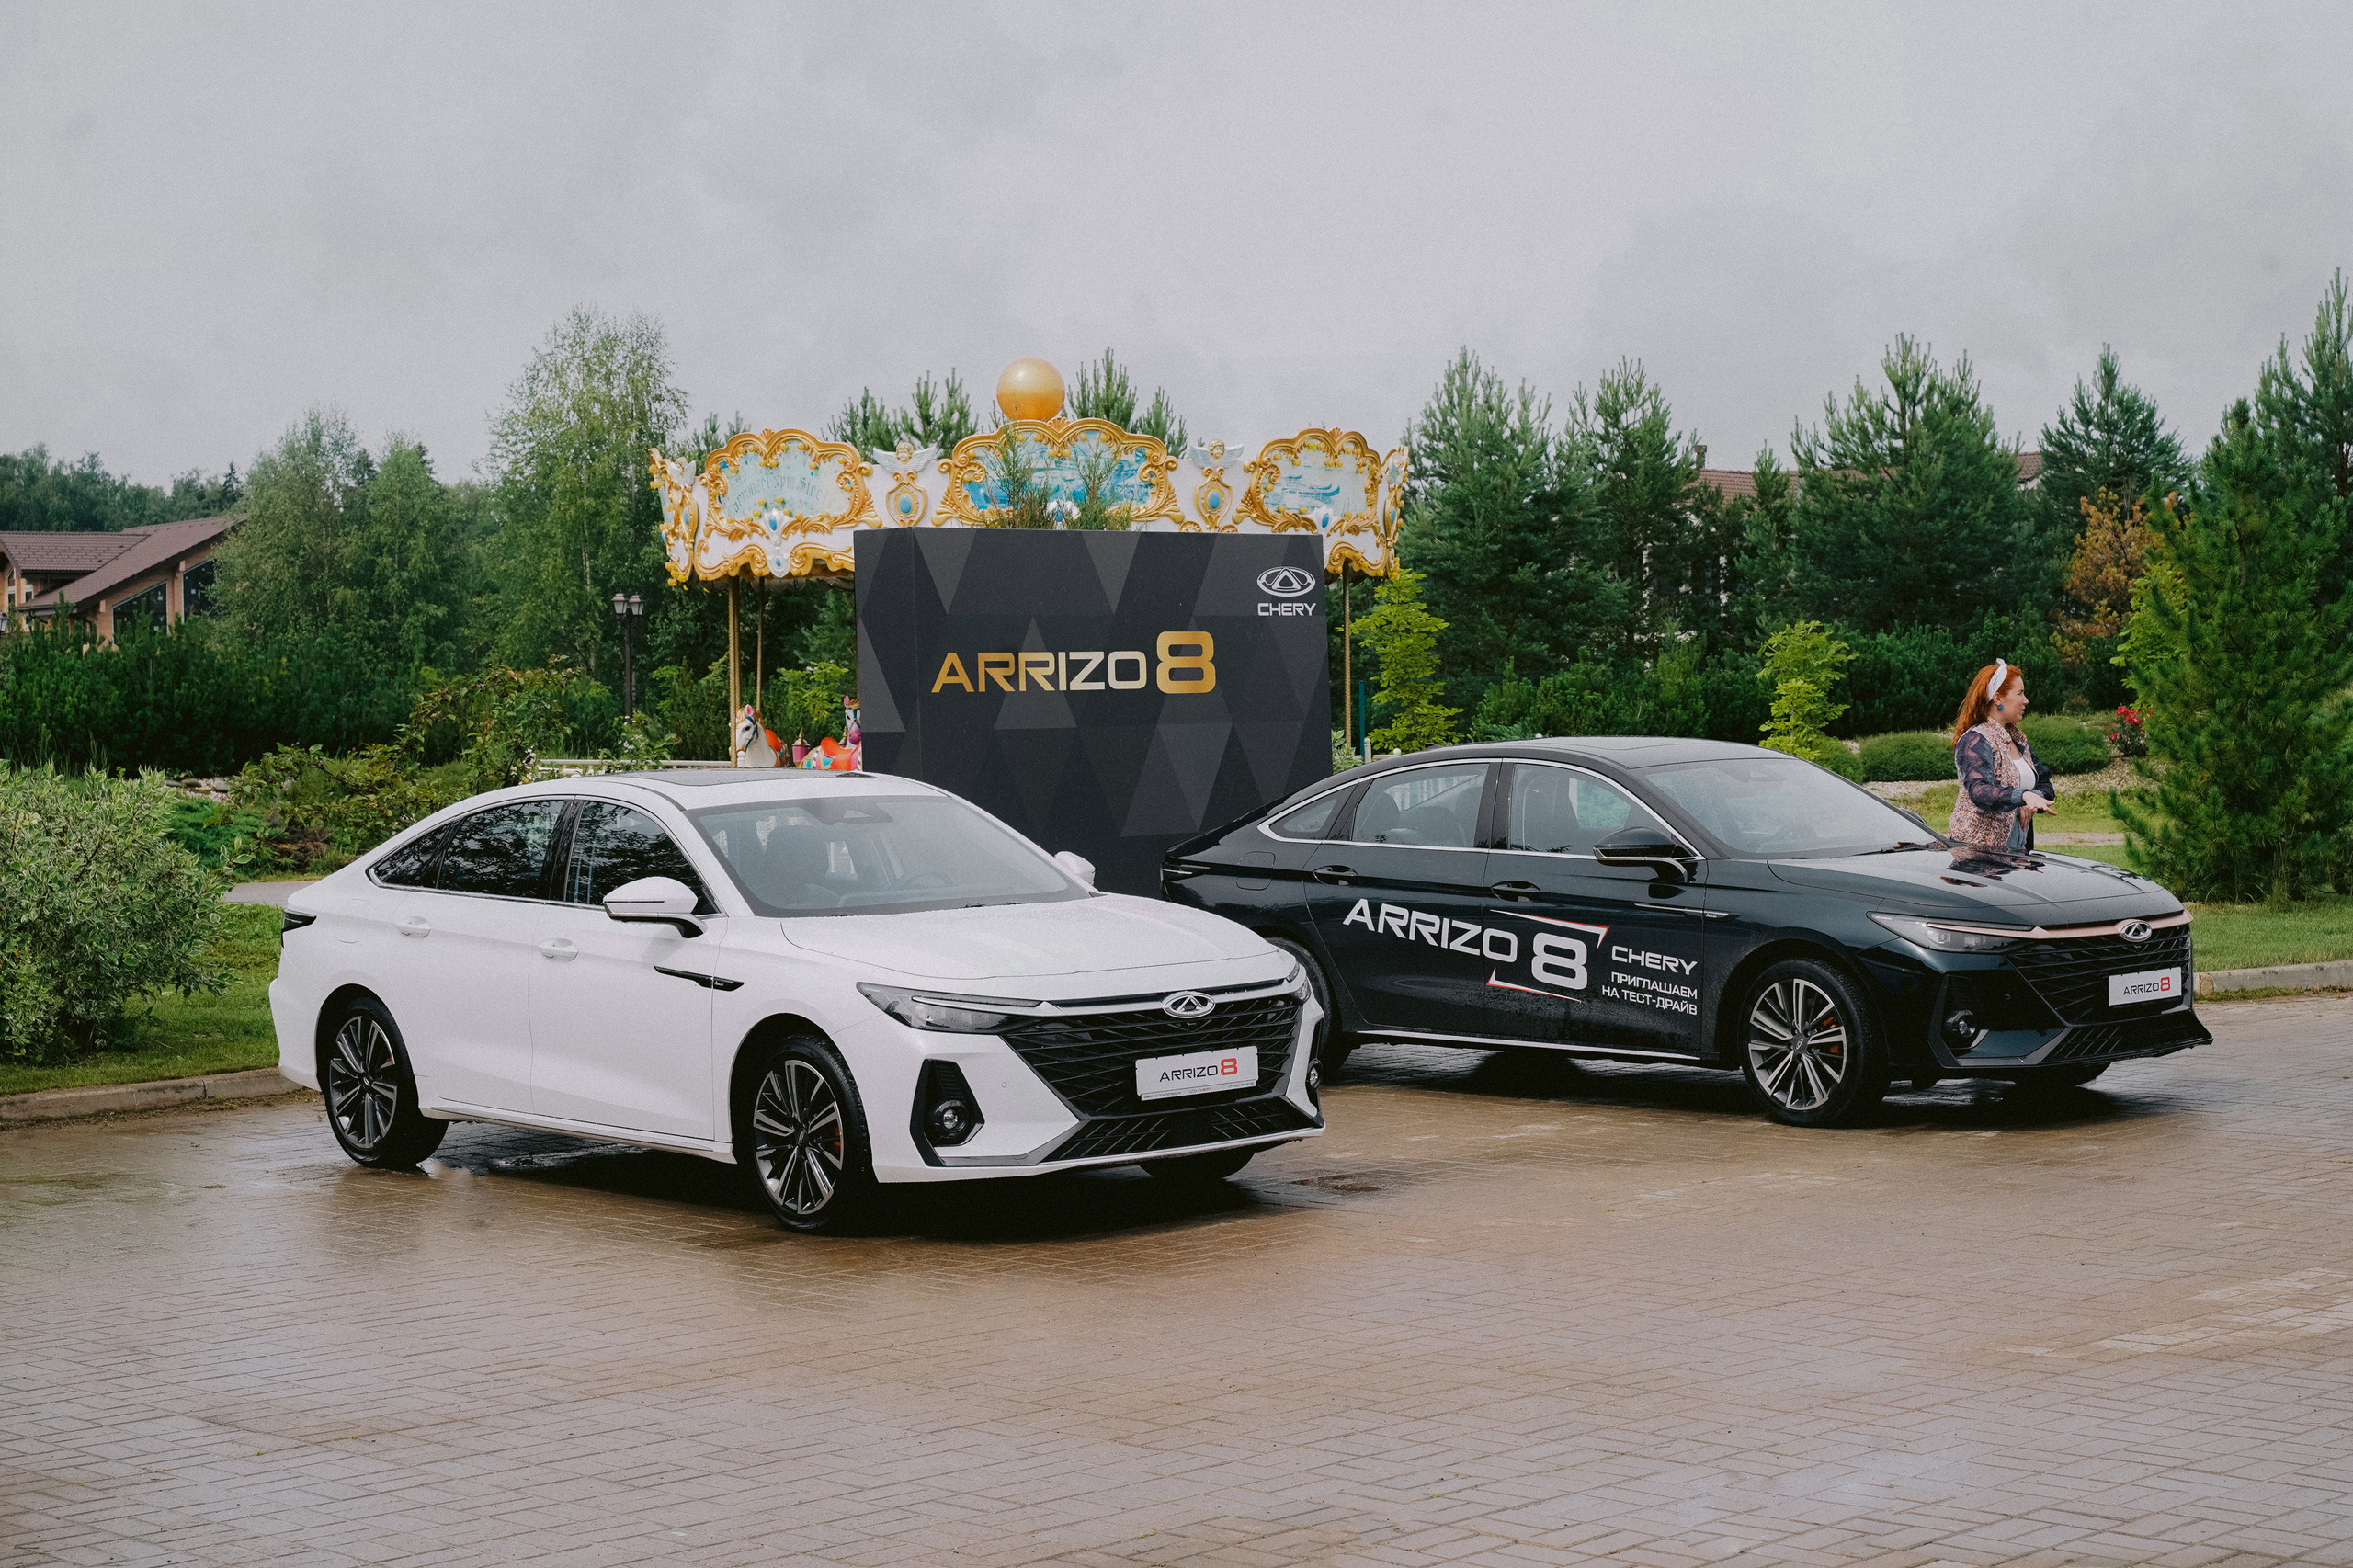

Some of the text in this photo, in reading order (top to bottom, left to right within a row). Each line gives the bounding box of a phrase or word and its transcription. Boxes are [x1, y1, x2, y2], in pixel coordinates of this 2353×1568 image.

[1257, 602, 1316, 617] CHERY
[931, 631, 1216, 694] ARRIZO 8
[1342, 898, 1588, 991] ARRIZO 8
[1611, 945, 1699, 976] CHERY
[1602, 985, 1699, 1016] НА ТЕСТ-ДРАЙВ
[1610, 971, 1699, 1001] ПРИГЛАШАЕМ
[2123, 977, 2170, 995] ARRIZO 8
[1159, 1057, 1238, 1083] ARRIZO 8
